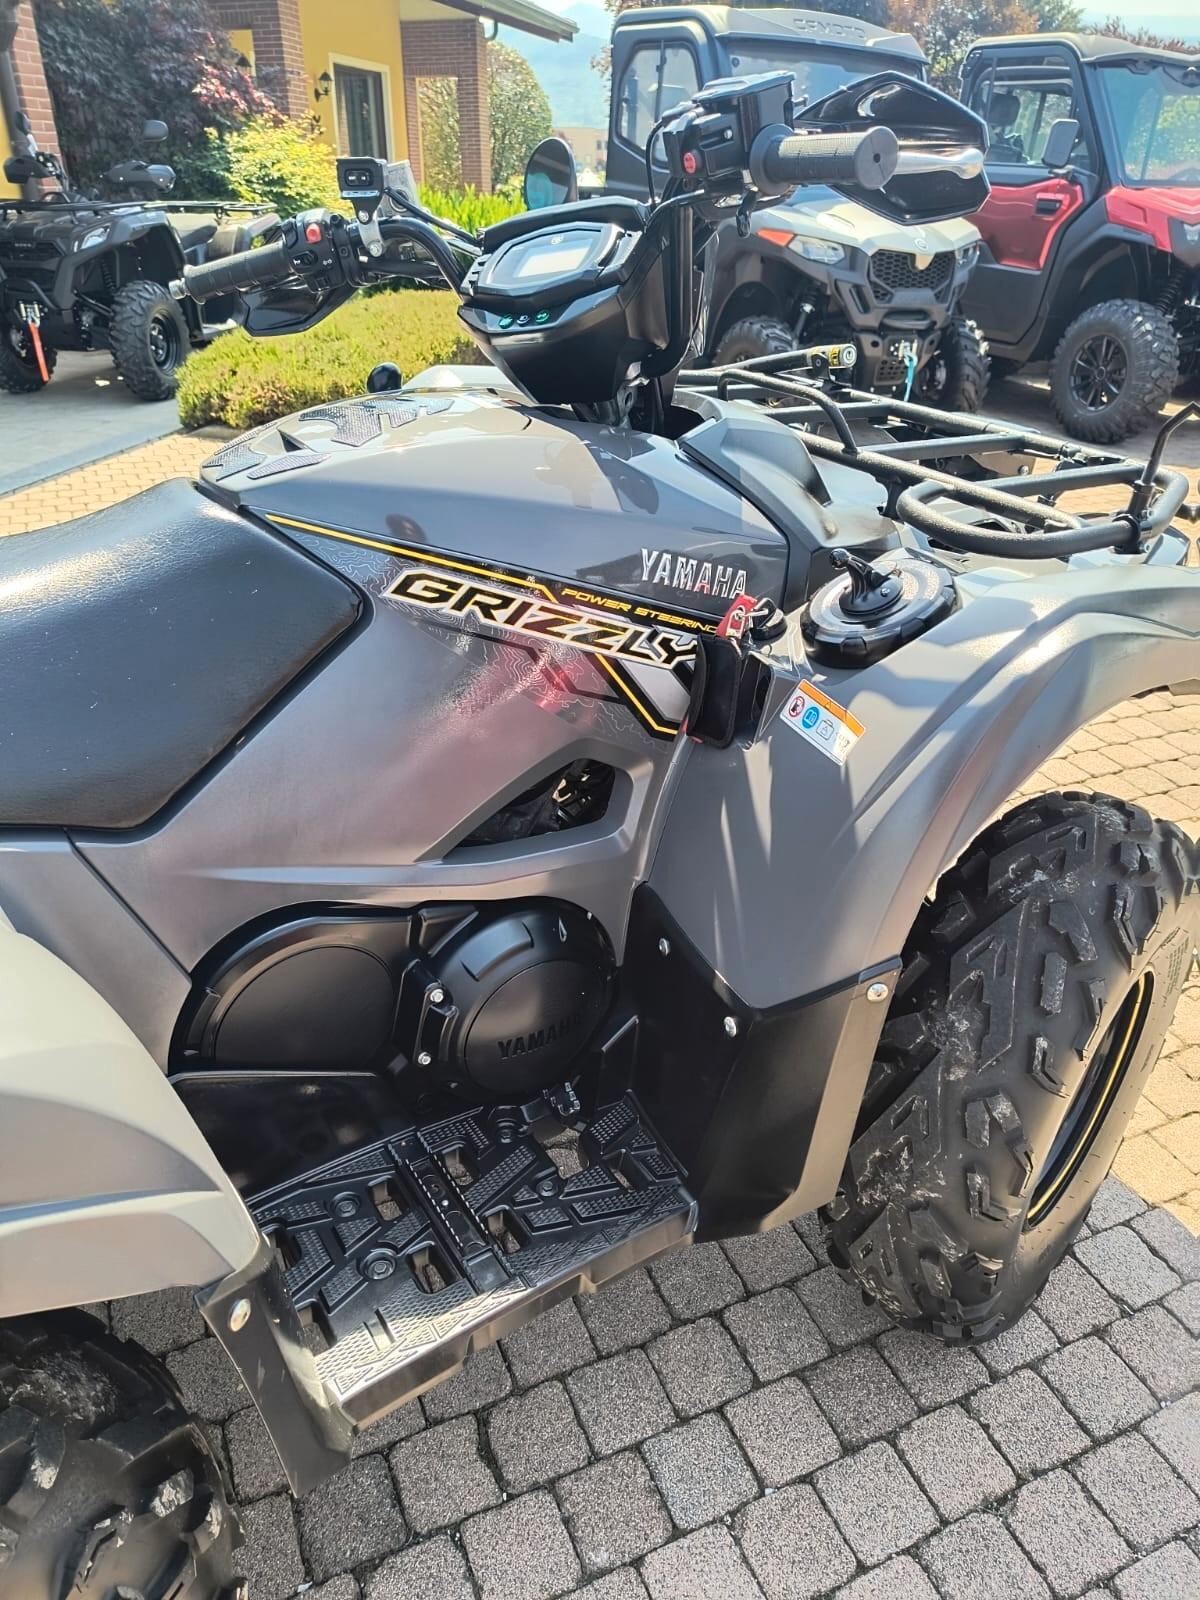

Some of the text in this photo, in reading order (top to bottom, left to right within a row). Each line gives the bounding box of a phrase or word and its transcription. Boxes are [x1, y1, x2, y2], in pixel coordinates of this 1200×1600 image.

[561, 588, 632, 612] POWER
[641, 548, 747, 600] YAMAHA
[385, 568, 698, 669] GRIZZLY
